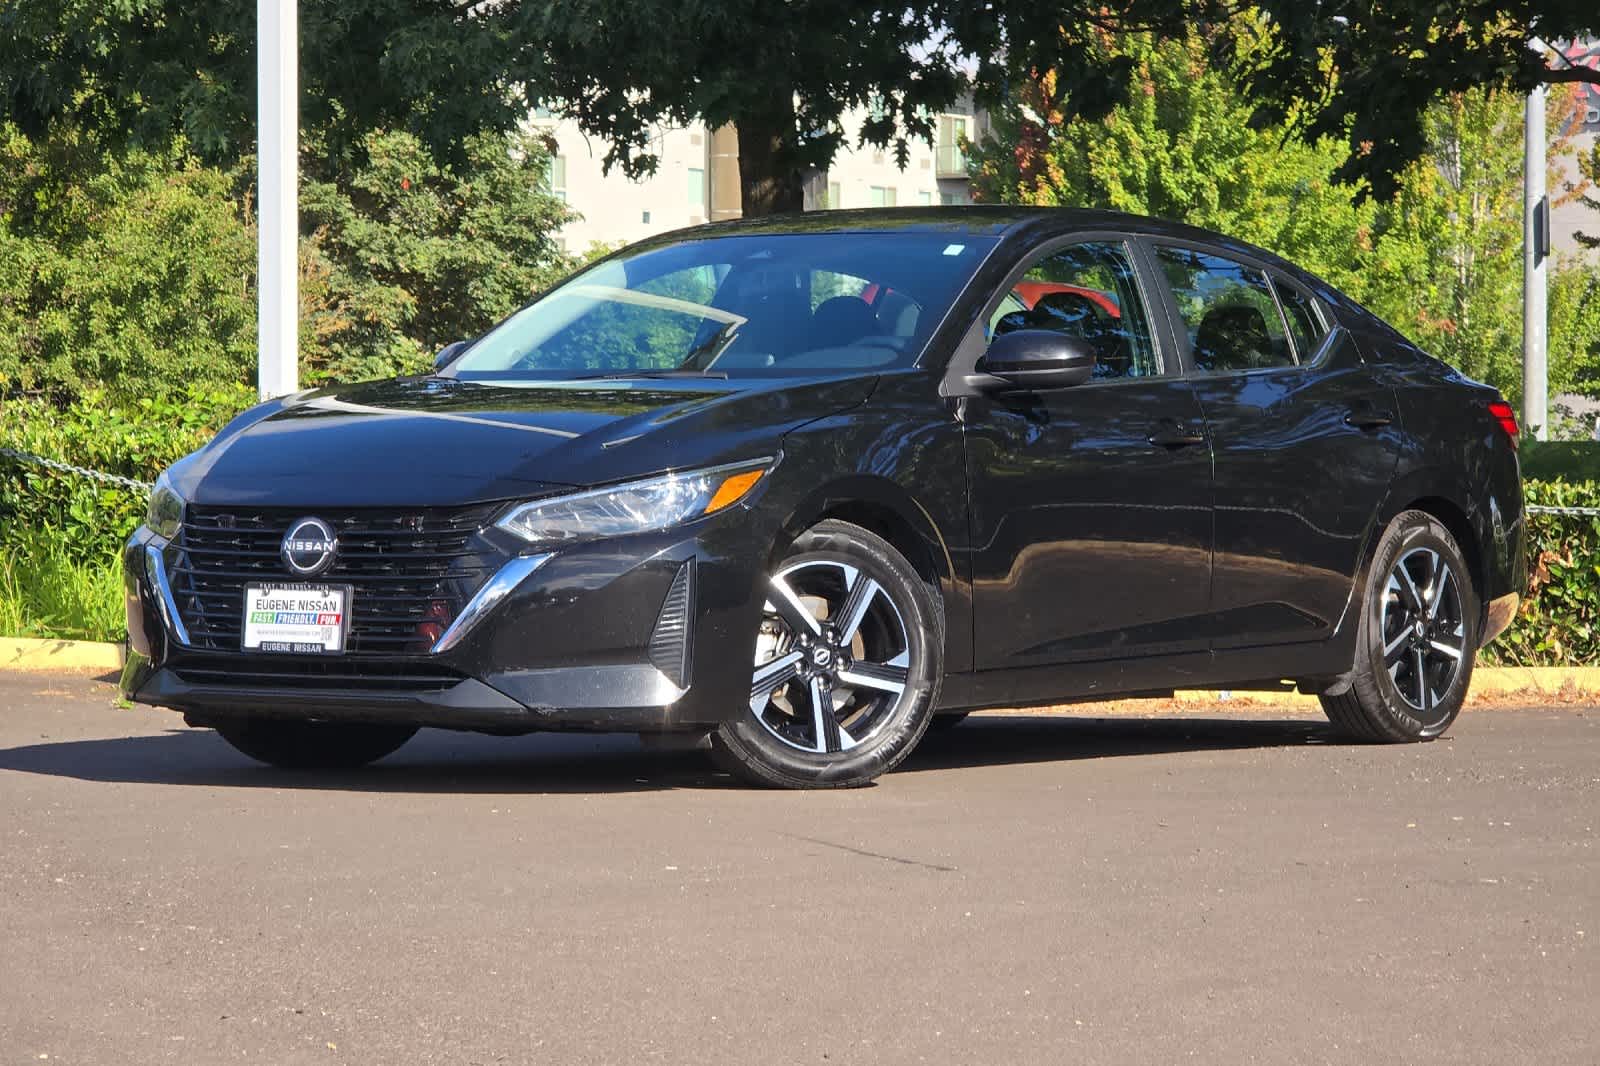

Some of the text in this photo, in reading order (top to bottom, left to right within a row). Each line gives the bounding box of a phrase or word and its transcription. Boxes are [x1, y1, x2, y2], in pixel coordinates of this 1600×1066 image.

[284, 540, 334, 552] NISSAN
[256, 599, 337, 612] EUGENE NISSAN
[278, 613, 315, 625] FRIENDLY.
[262, 642, 322, 653] EUGENE NISSAN
